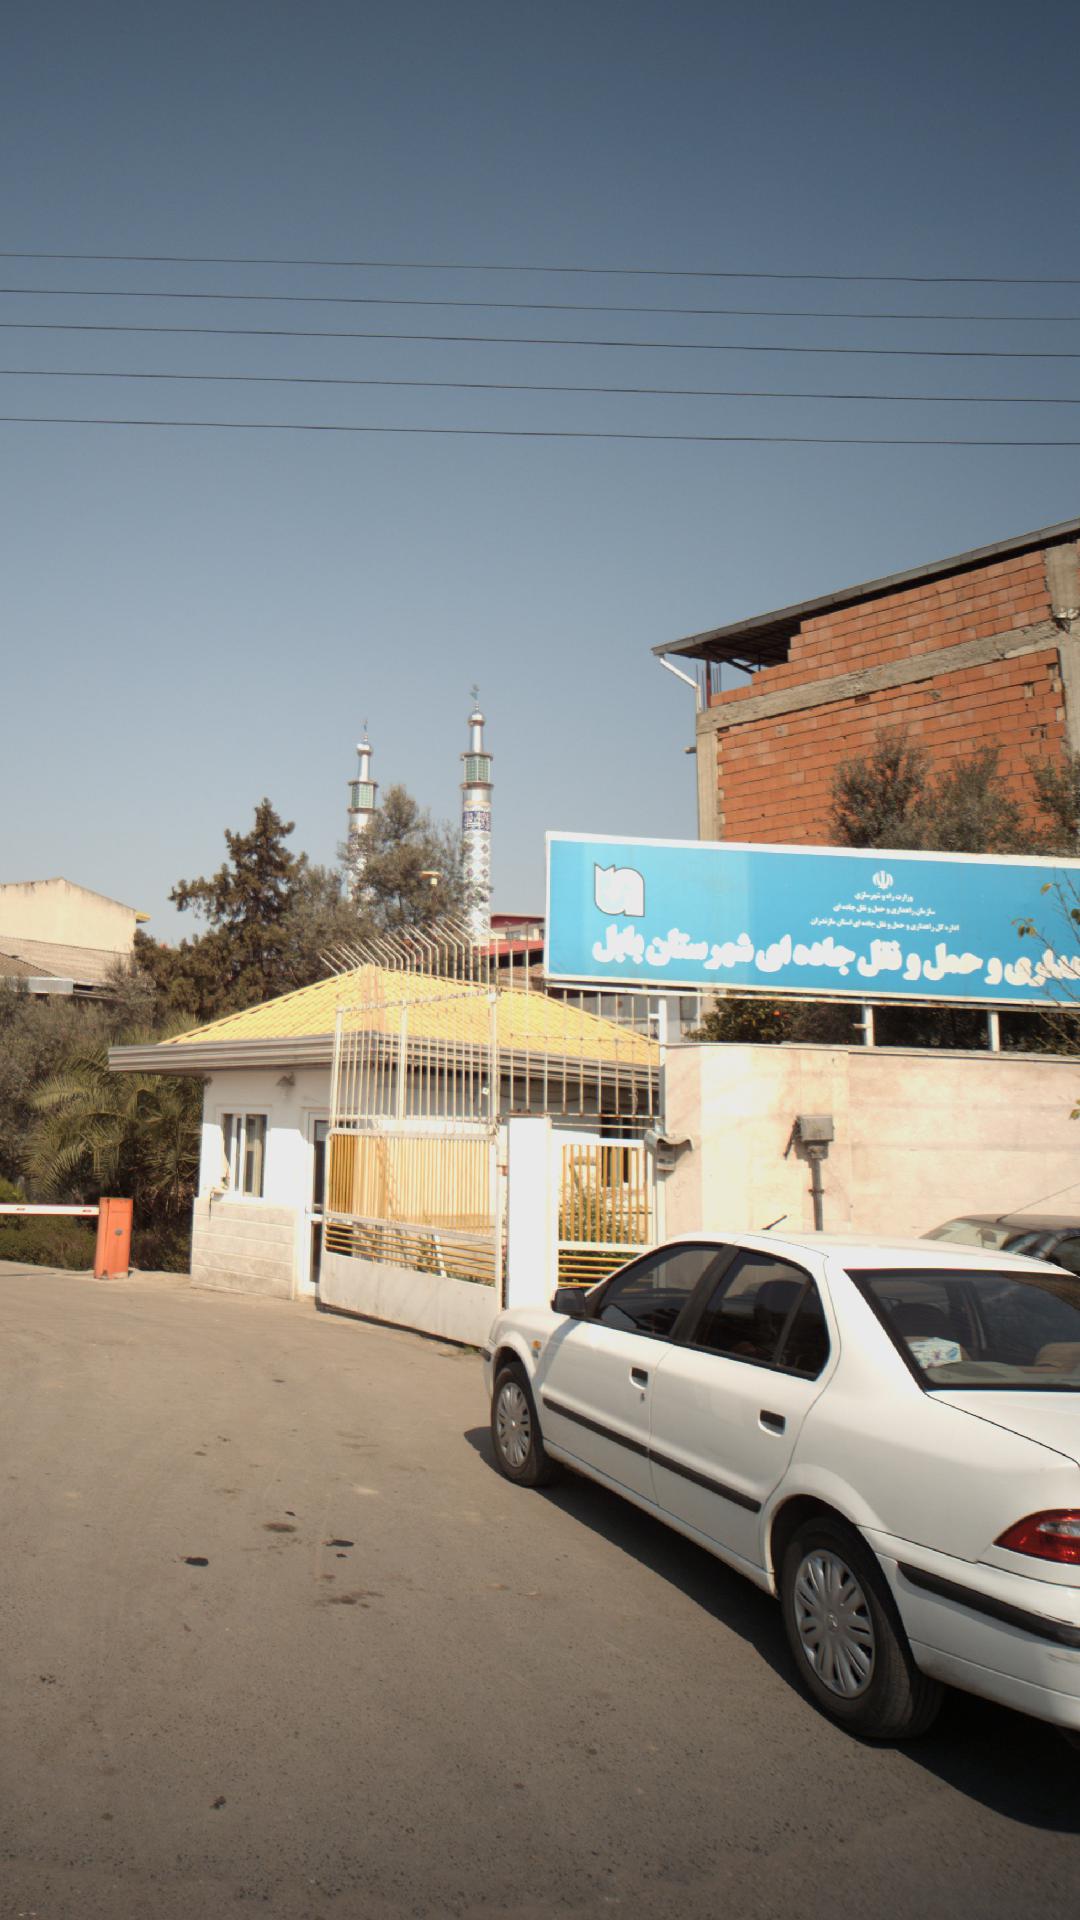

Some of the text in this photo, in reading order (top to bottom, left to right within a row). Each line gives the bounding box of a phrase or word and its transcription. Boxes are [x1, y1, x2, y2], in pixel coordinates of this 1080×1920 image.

[592, 923, 646, 966] بابل
[646, 928, 755, 970] شهرستان
[755, 934, 793, 973] ای
[793, 936, 856, 976] جاده
[857, 938, 903, 978] نقل
[922, 942, 984, 981] حمل
[902, 953, 922, 981] و
[984, 957, 1003, 985] و
